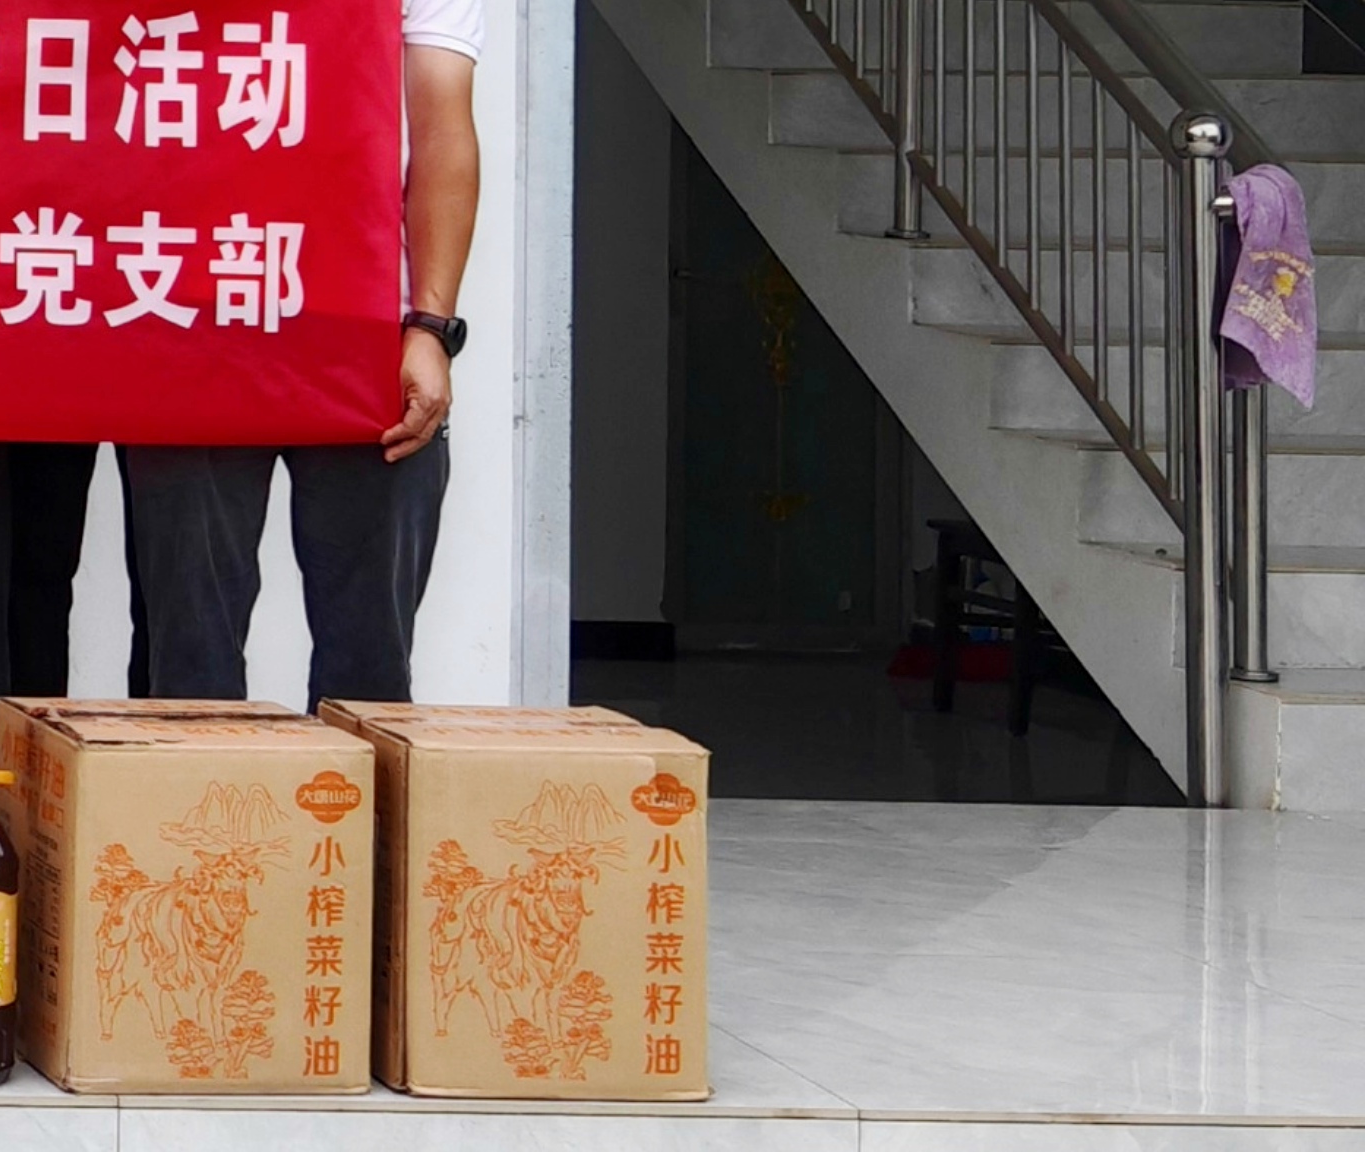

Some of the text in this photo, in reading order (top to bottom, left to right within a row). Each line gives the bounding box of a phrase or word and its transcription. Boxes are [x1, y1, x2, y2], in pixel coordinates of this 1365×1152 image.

[301, 835, 347, 1078] 小榨菜籽油
[643, 833, 686, 1076] 小榨菜籽油
